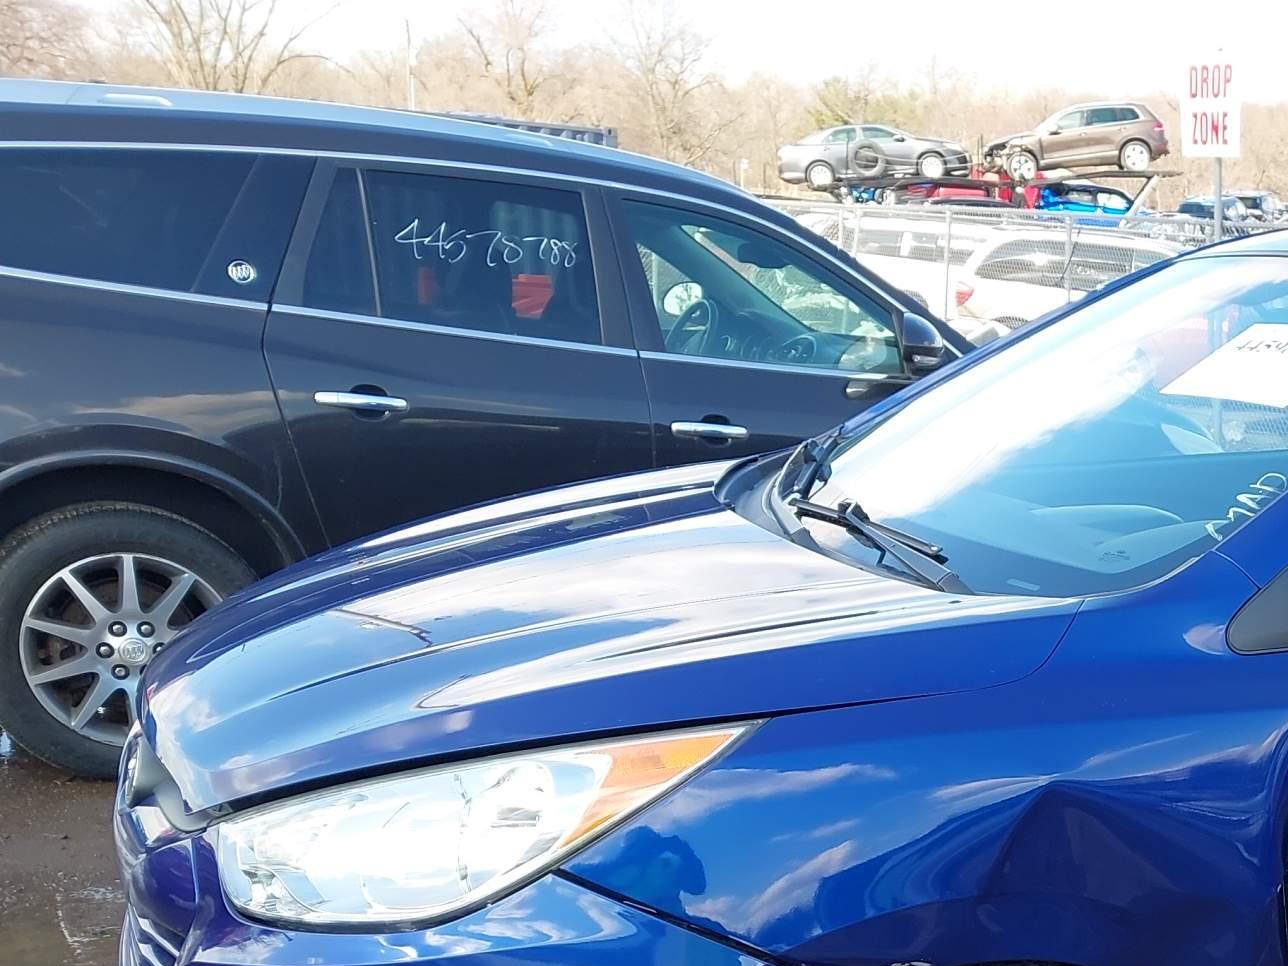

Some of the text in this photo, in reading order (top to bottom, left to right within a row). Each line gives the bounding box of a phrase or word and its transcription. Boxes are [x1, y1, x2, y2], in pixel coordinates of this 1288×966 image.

[1189, 64, 1232, 99] DROP
[1192, 111, 1229, 145] ZONE
[394, 218, 578, 268] 44578788
